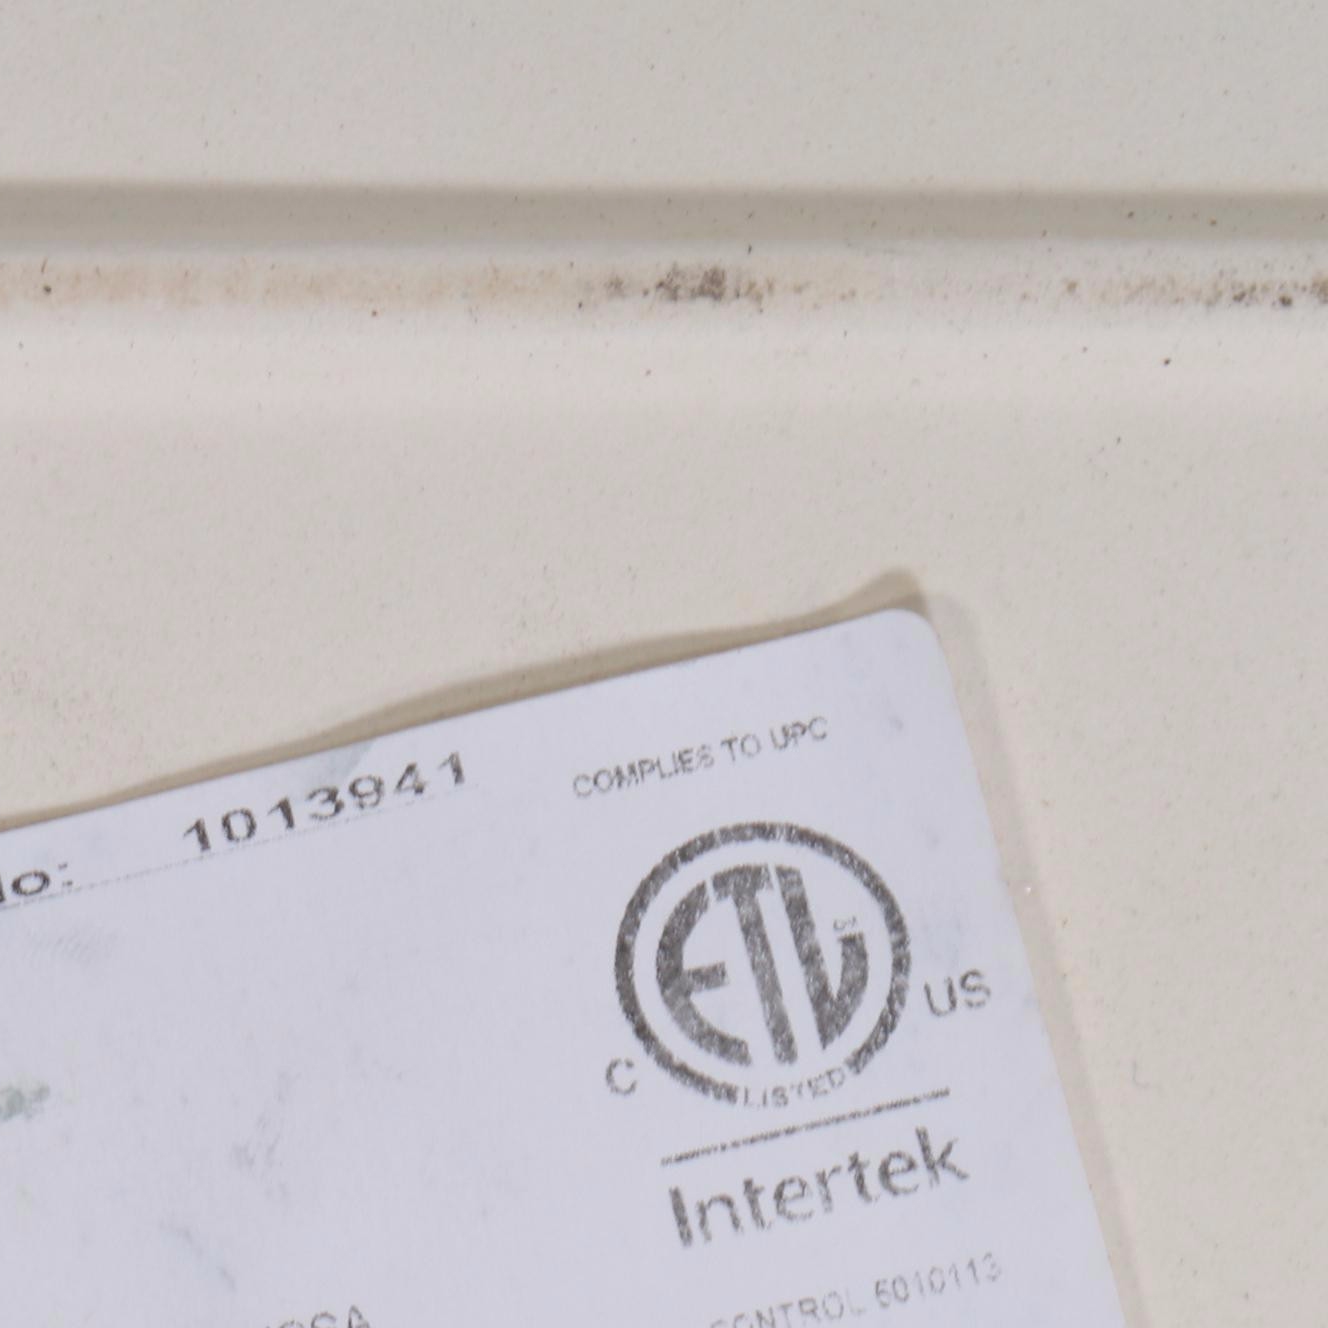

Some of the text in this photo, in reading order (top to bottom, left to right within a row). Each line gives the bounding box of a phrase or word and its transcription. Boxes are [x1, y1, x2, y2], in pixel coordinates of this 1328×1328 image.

[573, 716, 828, 797] COMPLIES TO UPC
[183, 751, 467, 853] 1013941
[655, 863, 870, 1066] ETL
[924, 969, 992, 1016] US
[605, 1057, 637, 1096] C
[744, 1067, 845, 1108] LISTED
[669, 1126, 969, 1246] Intertek
